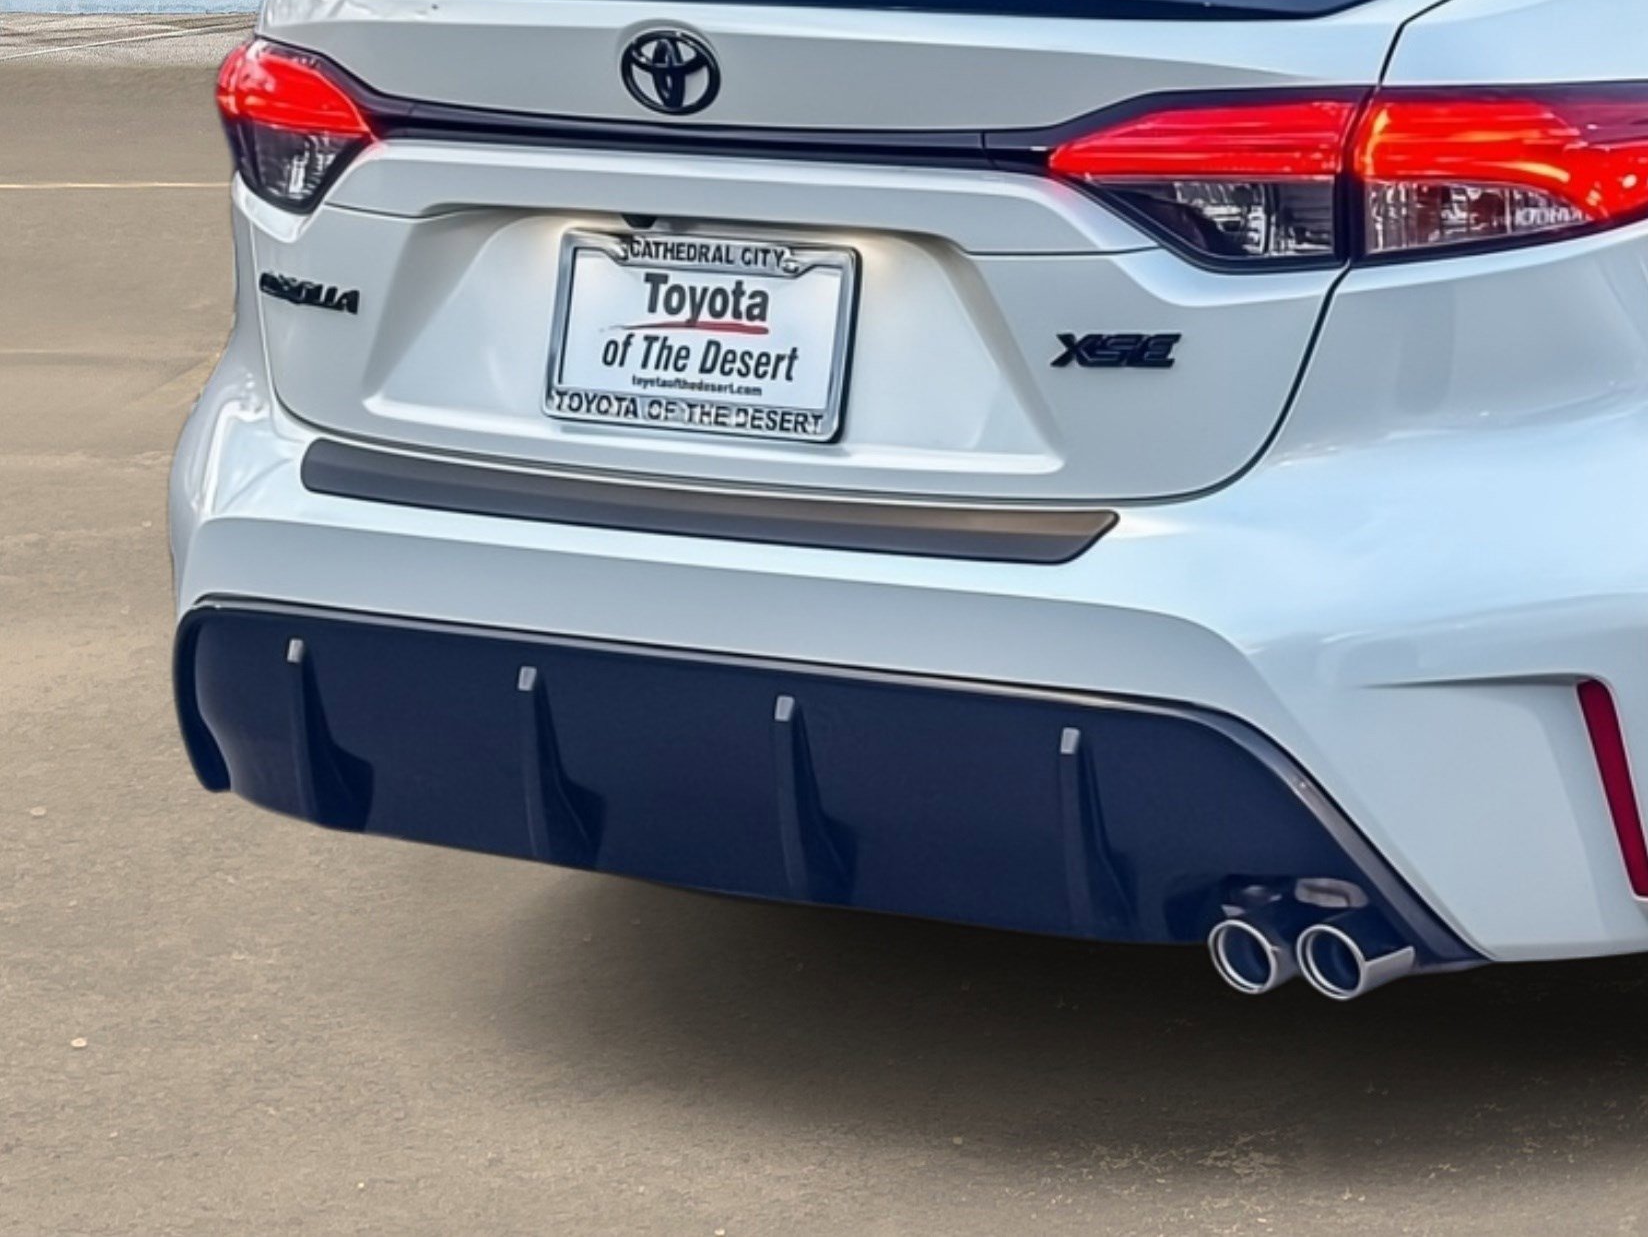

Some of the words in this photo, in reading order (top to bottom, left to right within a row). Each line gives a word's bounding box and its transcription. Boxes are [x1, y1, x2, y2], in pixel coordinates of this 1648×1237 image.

[630, 239, 735, 265] CATHEDRAL
[741, 247, 784, 268] CITY
[643, 272, 770, 324] Toyota
[601, 332, 637, 367] of
[639, 334, 691, 374] The
[699, 338, 799, 382] Desert
[555, 390, 639, 420] TOYOTA
[647, 399, 677, 422] OF
[684, 403, 728, 427] THE
[734, 407, 824, 436] DESERT
